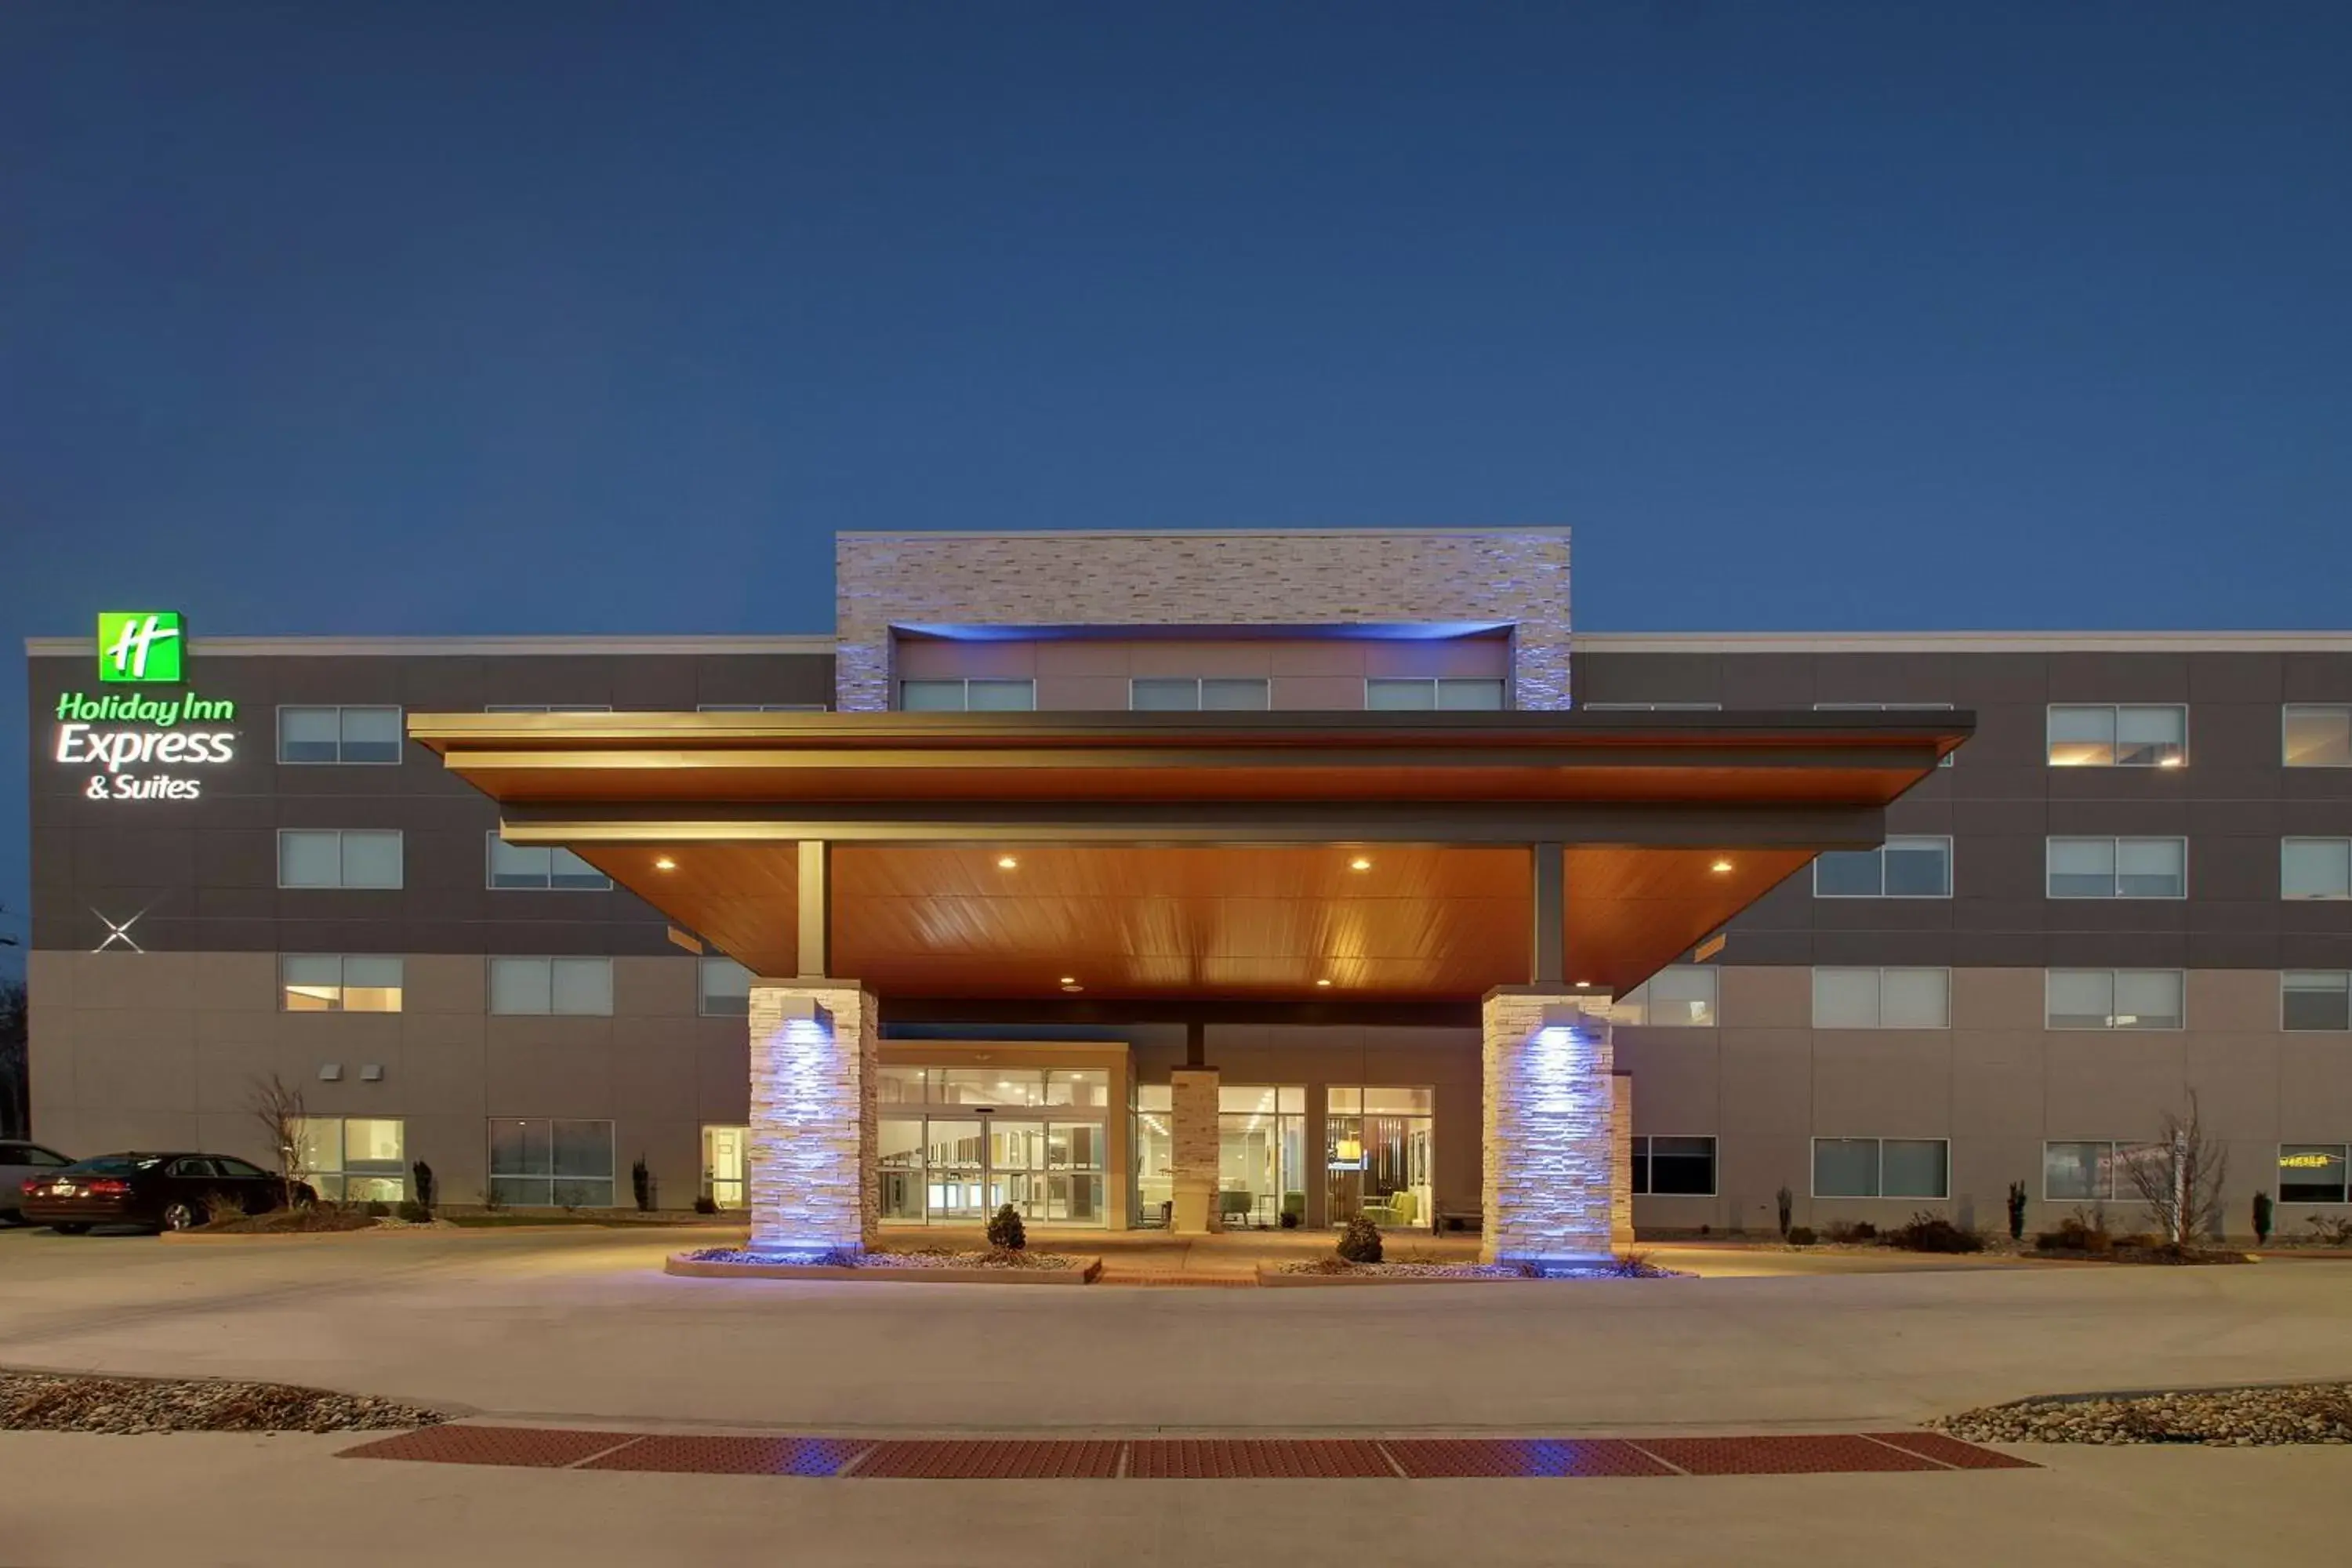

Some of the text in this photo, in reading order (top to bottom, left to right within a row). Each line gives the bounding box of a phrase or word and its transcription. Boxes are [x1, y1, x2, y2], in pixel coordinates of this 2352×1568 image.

[56, 692, 234, 726] Holiday Inn
[56, 724, 234, 772] Express
[86, 775, 200, 799] & Suites
